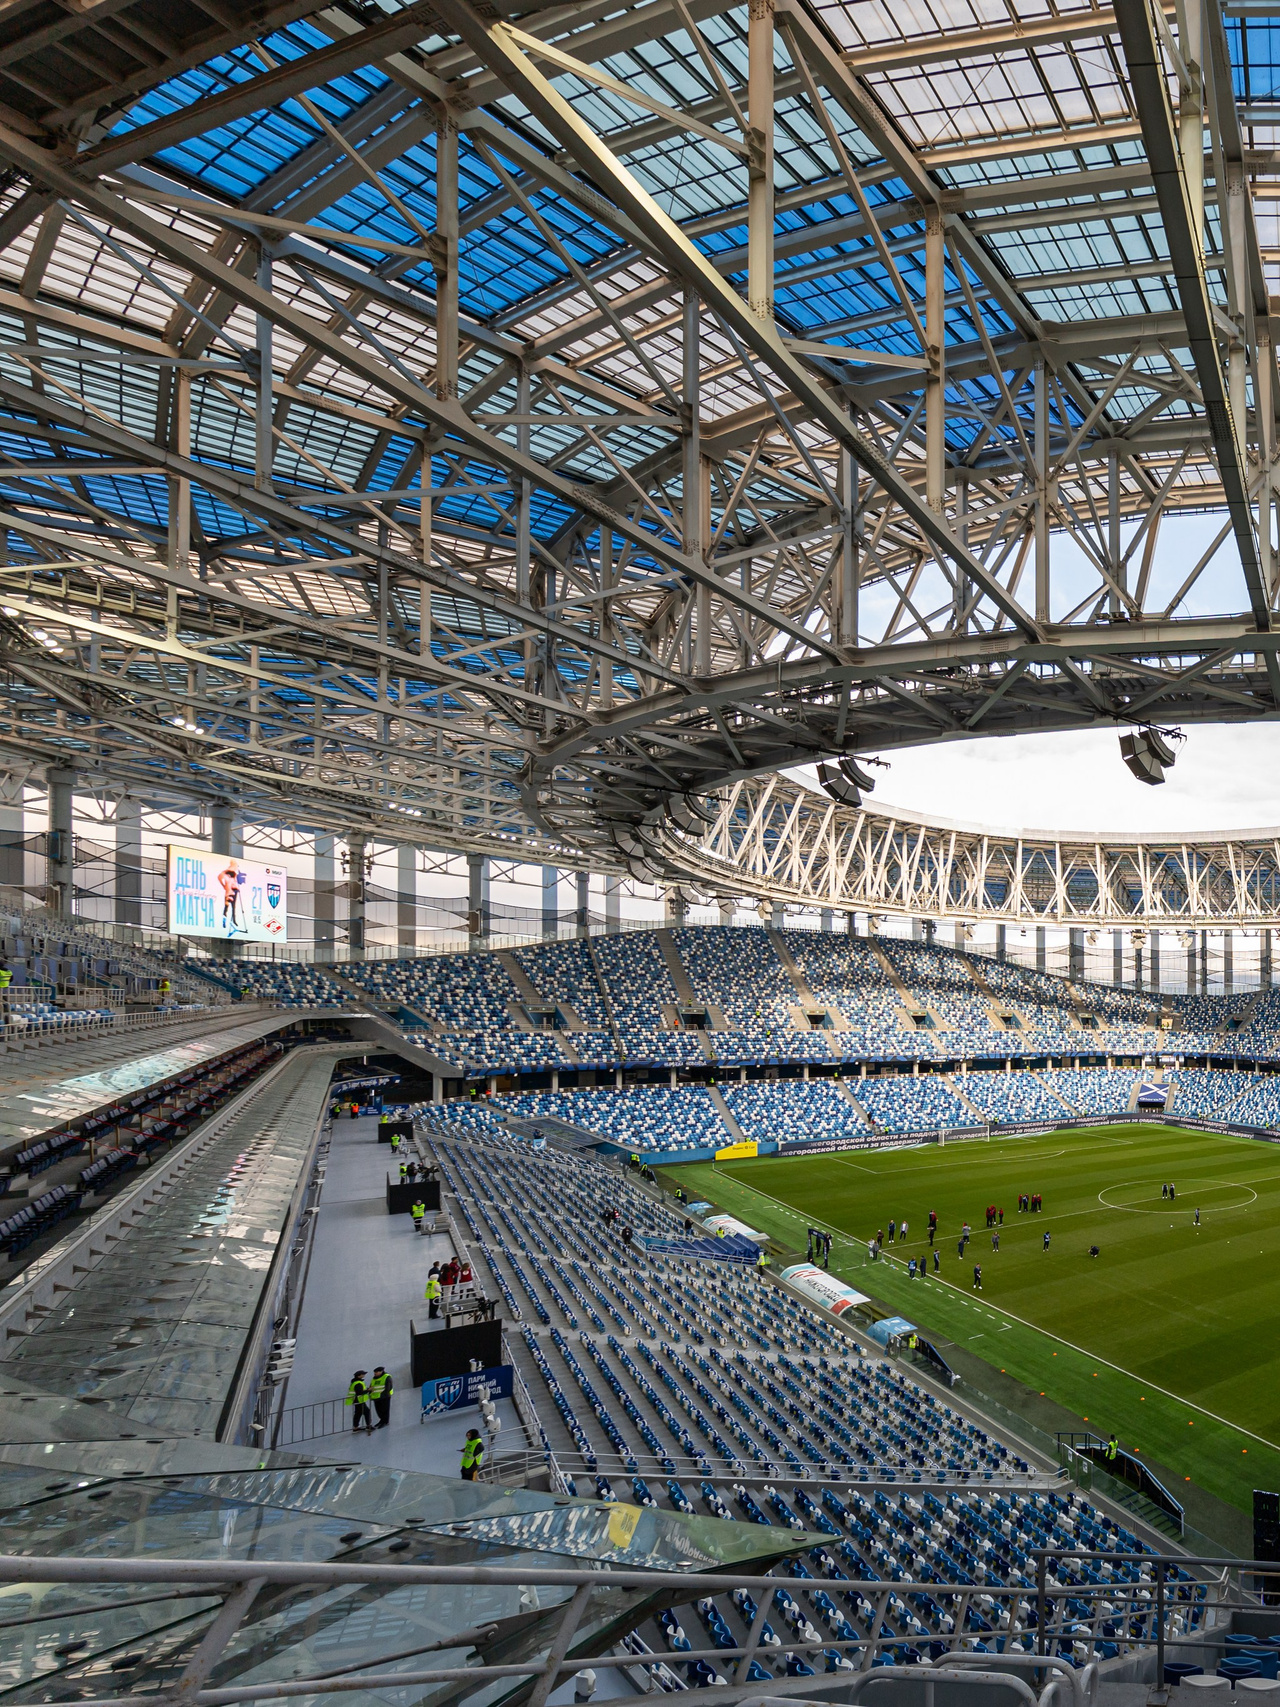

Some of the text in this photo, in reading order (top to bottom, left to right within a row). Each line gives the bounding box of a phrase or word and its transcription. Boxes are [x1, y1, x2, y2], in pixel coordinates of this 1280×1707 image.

[176, 857, 206, 891] ДЕНЬ
[176, 893, 215, 928] МАТЧА
[866, 1134, 899, 1142] области
[837, 1143, 868, 1151] области
[468, 1375, 486, 1384] ПАРИ
[468, 1379, 497, 1392] НИНИЙ
[468, 1387, 502, 1400] НОРОД
